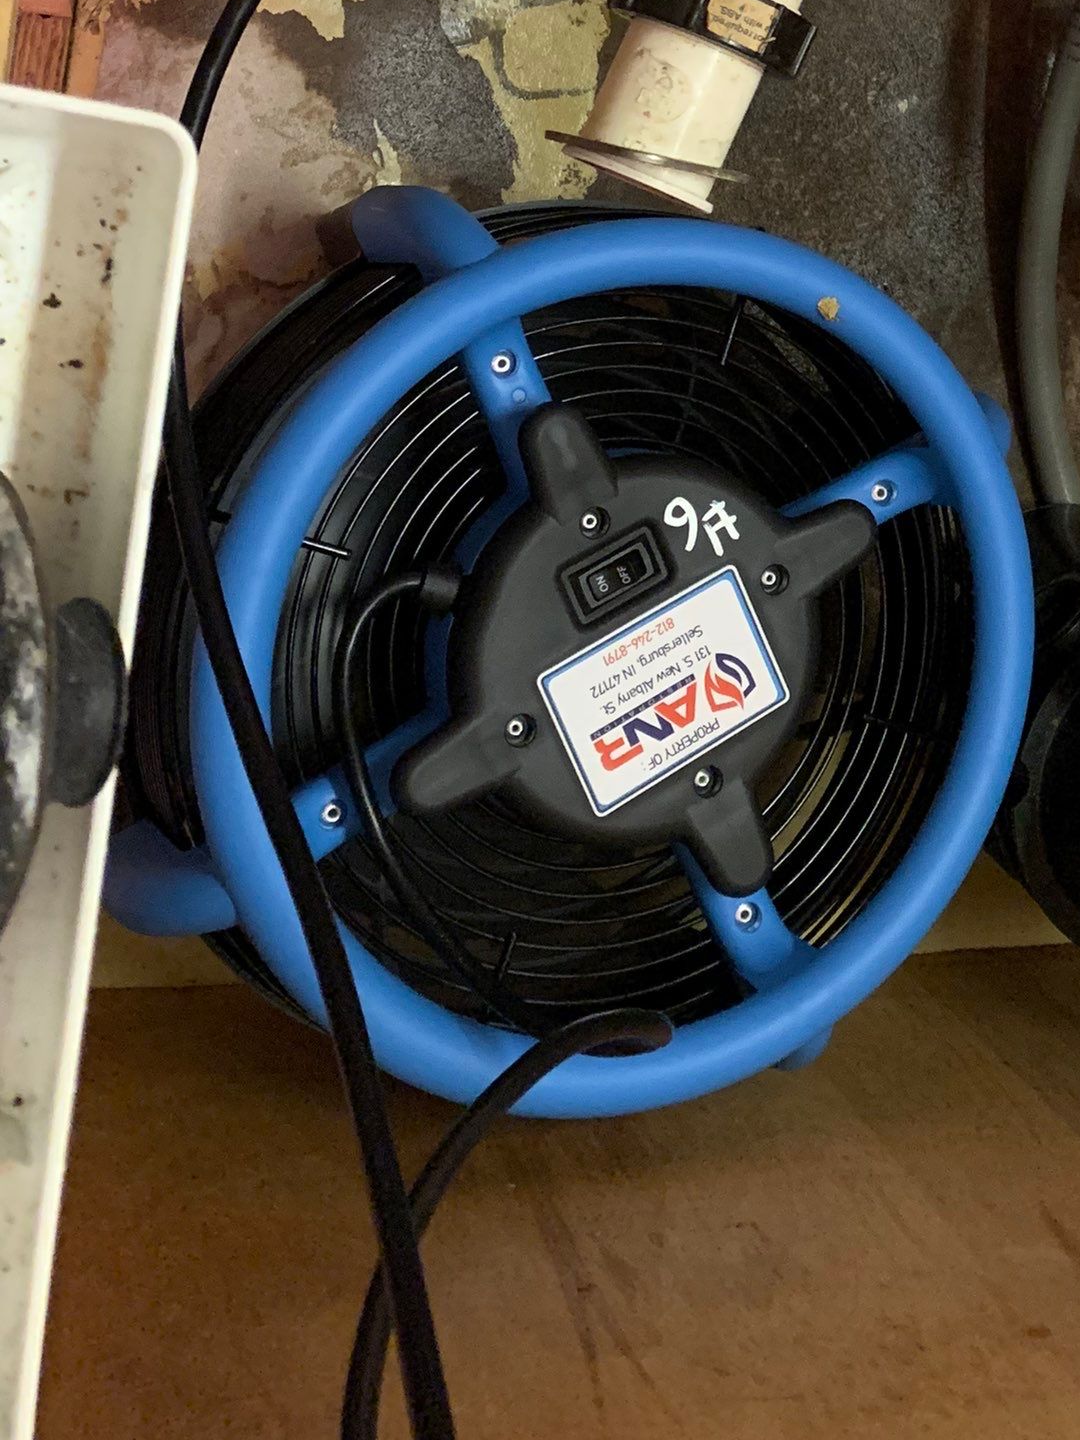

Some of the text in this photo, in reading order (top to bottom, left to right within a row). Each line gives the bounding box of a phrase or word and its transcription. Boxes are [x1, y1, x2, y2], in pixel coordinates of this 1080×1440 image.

[595, 575, 609, 593] ON
[616, 566, 631, 584] OFF
[603, 618, 675, 666] 812-246-8791
[695, 645, 711, 661] 131
[589, 625, 704, 699] Sellersburg, IN 47172
[656, 662, 682, 682] New
[618, 678, 654, 705] Albany
[591, 675, 694, 740] RESTORATION
[600, 701, 616, 715] St.
[593, 682, 697, 772] ANR
[665, 718, 721, 761] PROPERTY
